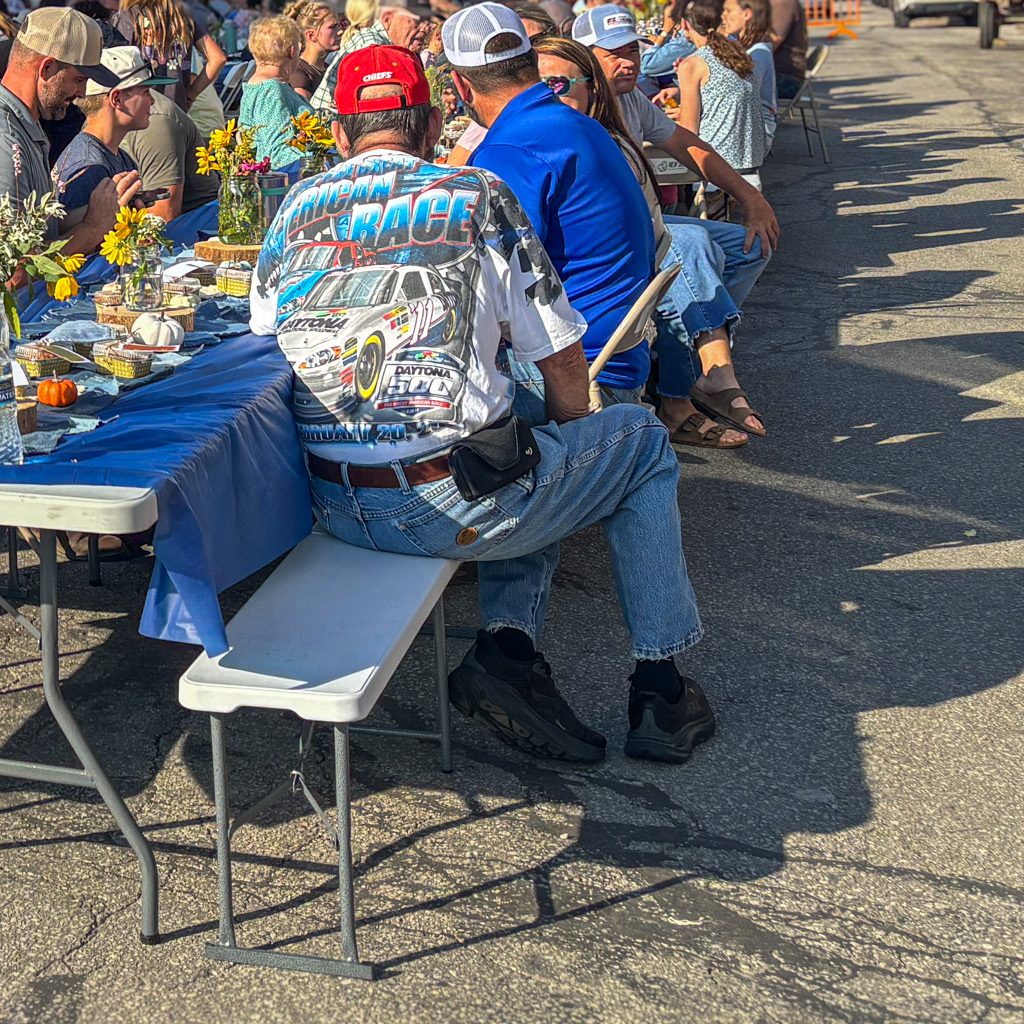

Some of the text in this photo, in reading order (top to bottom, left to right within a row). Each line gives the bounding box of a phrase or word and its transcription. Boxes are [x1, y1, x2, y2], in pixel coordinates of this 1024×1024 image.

[362, 71, 393, 82] CHIEFS
[282, 171, 397, 236] ERICAN
[349, 189, 481, 251] RACE
[395, 366, 451, 378] DAYTONA
[387, 376, 453, 396] 500
